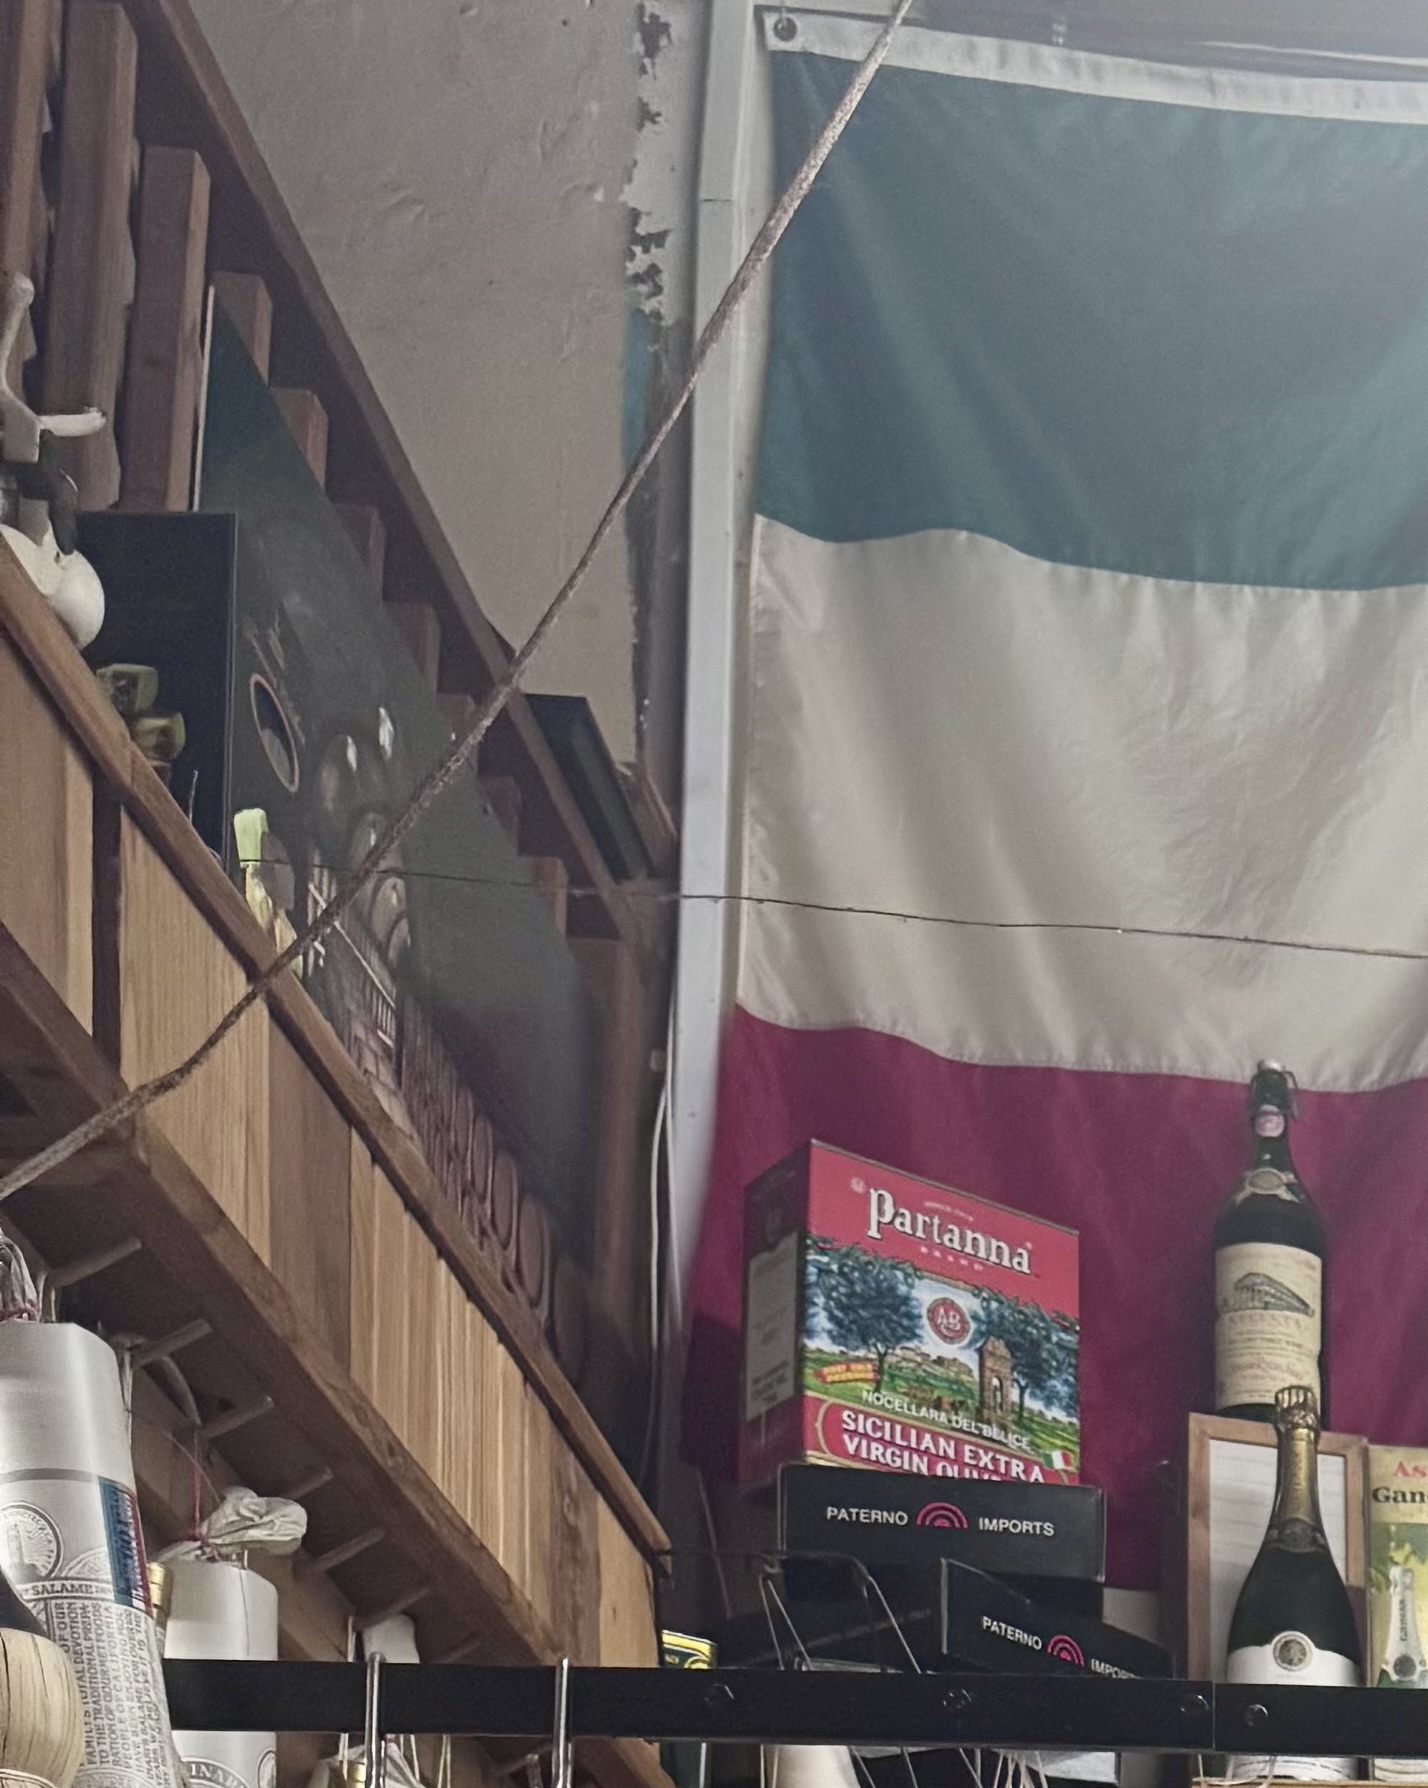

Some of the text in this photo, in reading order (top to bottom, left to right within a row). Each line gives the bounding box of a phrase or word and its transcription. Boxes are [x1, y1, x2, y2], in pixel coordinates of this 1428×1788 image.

[867, 1188, 1031, 1275] Partanna
[862, 1391, 949, 1425] NOCELLARA
[842, 1410, 1044, 1483] SICILIAN EXTRA
[843, 1434, 928, 1476] VIRGIN
[825, 1505, 1055, 1538] PATERNO IMPORTS
[981, 1616, 1043, 1652] PATERNO
